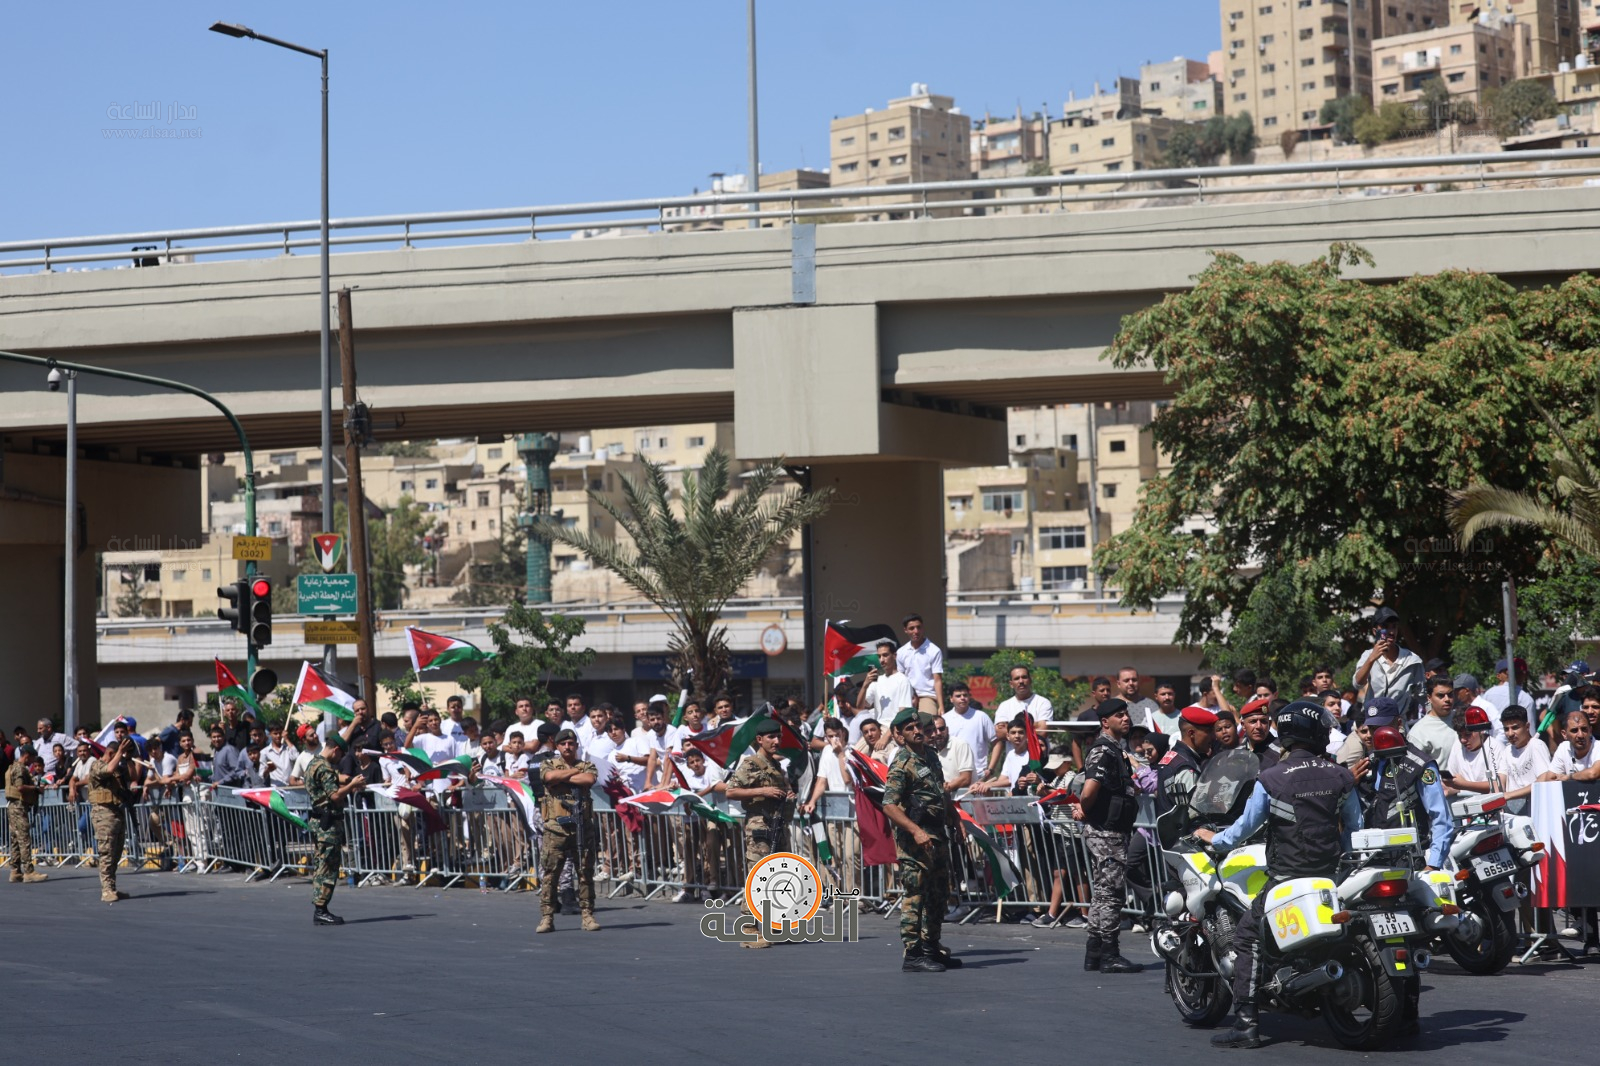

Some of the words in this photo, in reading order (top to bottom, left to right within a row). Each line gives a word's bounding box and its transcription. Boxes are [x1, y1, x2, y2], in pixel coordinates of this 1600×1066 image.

[240, 550, 264, 558] (302)
[304, 576, 322, 587] رعاية
[323, 576, 350, 587] جمعية
[298, 591, 320, 602] الخيرية
[1283, 761, 1310, 774] السير
[1488, 852, 1500, 863] 90
[1484, 860, 1514, 876] 86598
[1275, 902, 1300, 939] 35
[1384, 912, 1397, 923] 99
[1379, 922, 1410, 935] 21913
